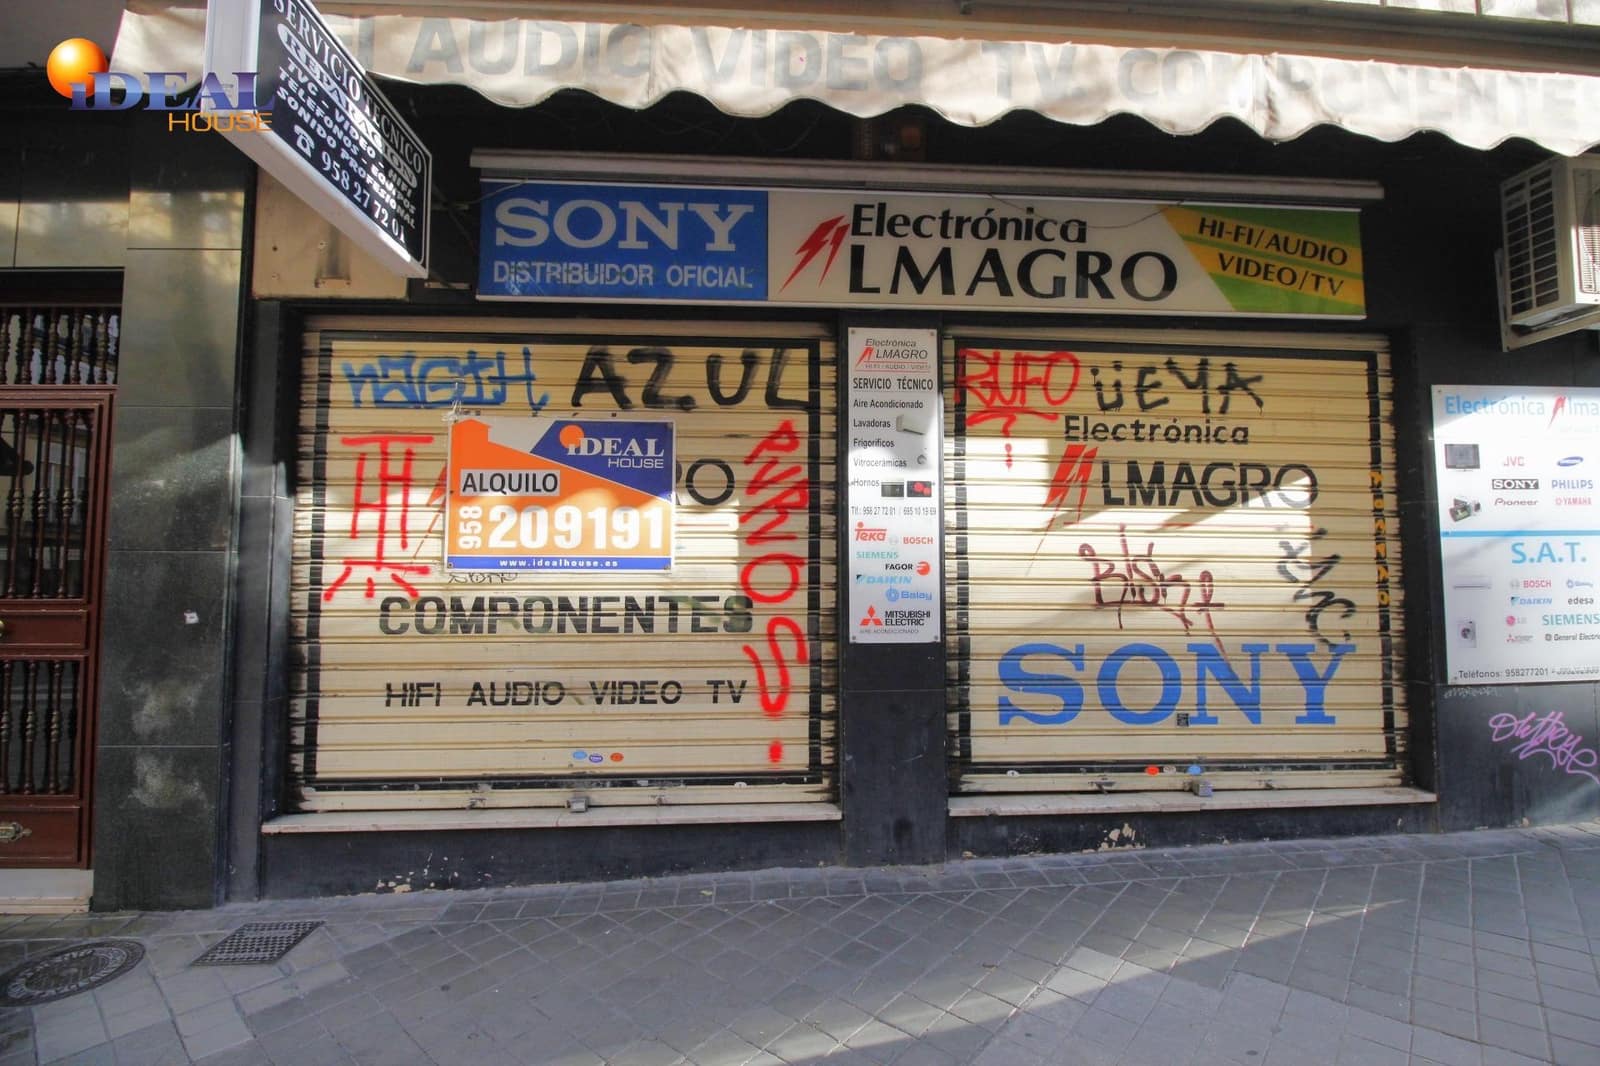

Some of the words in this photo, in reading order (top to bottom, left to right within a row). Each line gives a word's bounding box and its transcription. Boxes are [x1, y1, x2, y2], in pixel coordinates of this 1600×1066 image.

[405, 17, 652, 77] AUDIO
[690, 25, 923, 91] VIDEO
[279, 66, 359, 156] TELEFONOS
[288, 57, 319, 96] TVC
[334, 106, 376, 160] VIDEO
[388, 168, 412, 199] HIFI
[276, 86, 337, 148] SONIDO
[340, 148, 416, 229] PROFESIONAL
[321, 151, 350, 191] 958
[353, 181, 370, 208] 27
[373, 200, 389, 227] 72
[392, 217, 405, 243] 01
[495, 198, 754, 252] SONY
[851, 203, 1087, 244] Electrónica
[1198, 217, 1348, 266] HI-FI/AUDIO
[493, 260, 654, 287] DISTRIBUIDOR
[666, 264, 754, 289] OFICIAL
[1218, 252, 1344, 296] VIDEO/TV
[853, 377, 892, 390] SERVICIO
[896, 376, 934, 391] TÉCNICO
[853, 399, 868, 408] Aire
[870, 399, 924, 409] Acondicionado
[853, 418, 891, 428] Lavadoras
[1064, 415, 1249, 445] Electrónica
[608, 458, 665, 469] HOUSE
[1503, 456, 1525, 466] JVC
[462, 472, 558, 495] ALQUILO
[1493, 479, 1537, 489] SONY
[1552, 479, 1594, 489] PHILIPS
[1494, 497, 1539, 506] Pioneer
[1563, 497, 1592, 505] YAMAHA
[458, 505, 483, 550] 958
[487, 504, 664, 550] 209191
[903, 536, 934, 545] BOSCH
[856, 551, 899, 559] SIEMENS
[1511, 542, 1587, 564] S.A.T.
[499, 559, 619, 568] www.idealhouse.es
[885, 563, 913, 571] FAGOR
[866, 576, 912, 584] DAIKIN
[1523, 580, 1552, 588] BOSCH
[901, 591, 933, 601] Balay
[1567, 596, 1594, 605] edesa
[379, 595, 754, 635] COMPONENTES
[885, 610, 931, 619] MITSUBISHI
[1542, 614, 1600, 626] SIEMENS
[885, 618, 925, 626] ELECTRIC
[1553, 633, 1577, 641] General
[997, 642, 1357, 726] SONY
[385, 682, 441, 708] HIFI
[467, 680, 567, 708] AUDIO
[588, 680, 684, 706] VIDEO
[706, 679, 747, 704] TV
